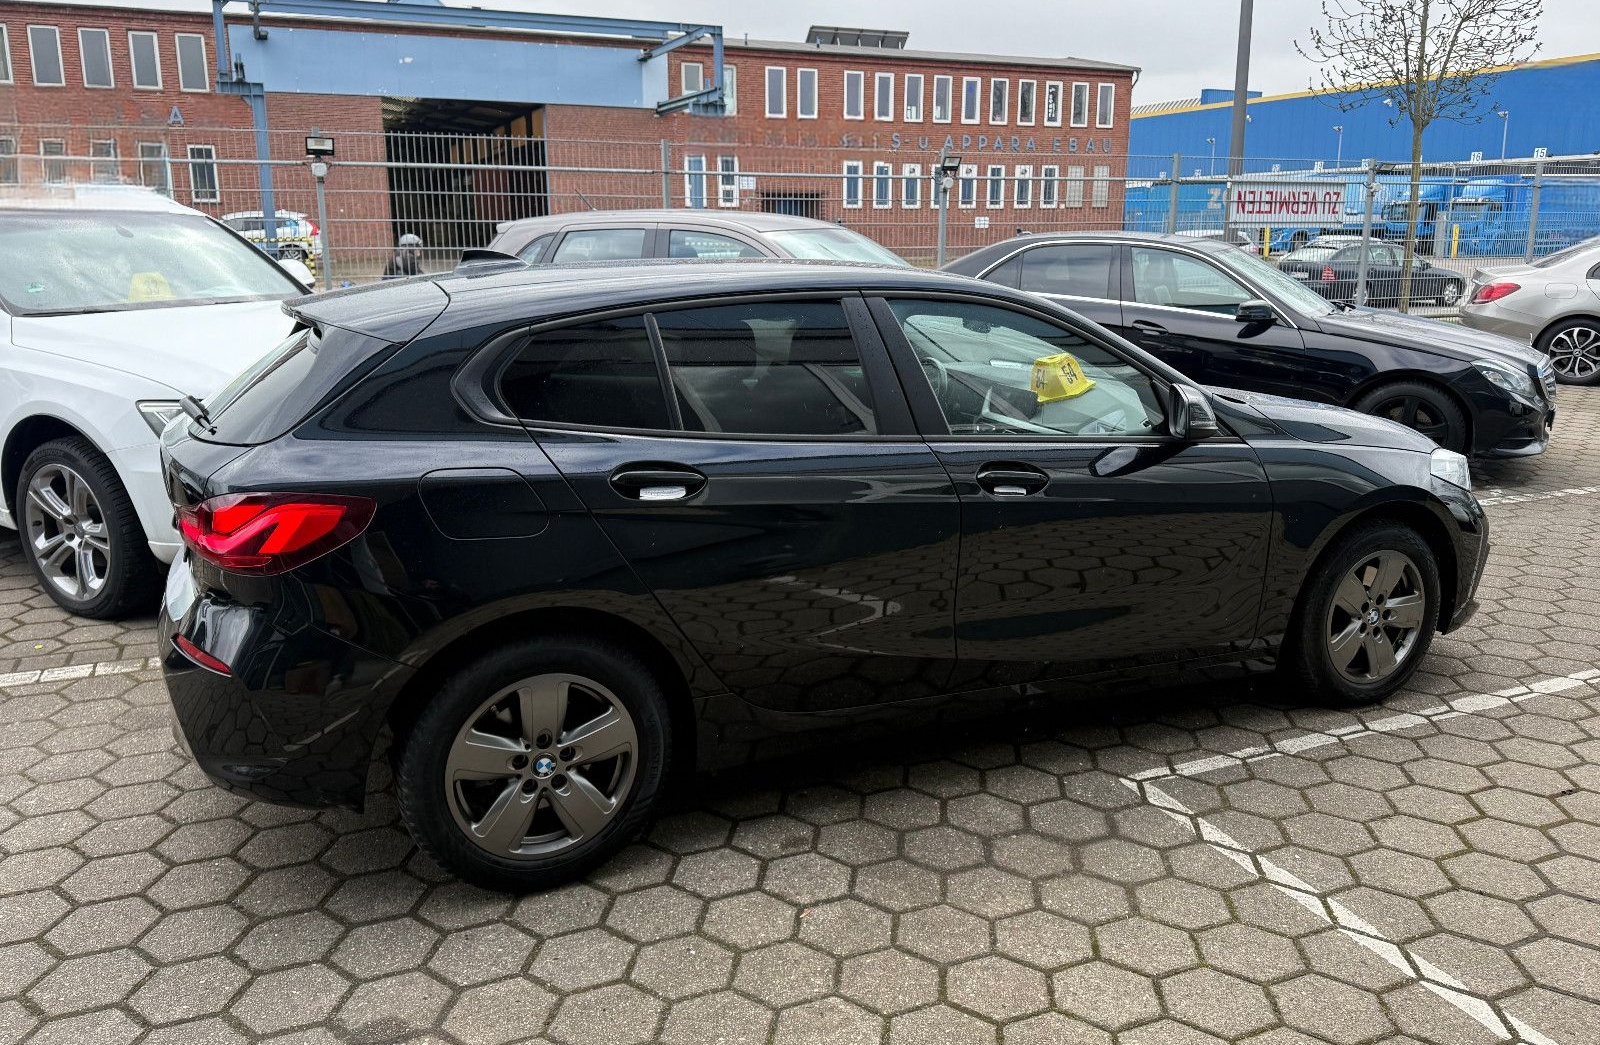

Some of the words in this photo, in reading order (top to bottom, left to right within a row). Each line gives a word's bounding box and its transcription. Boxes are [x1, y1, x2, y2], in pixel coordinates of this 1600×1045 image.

[1535, 148, 1546, 158] 15
[1236, 190, 1318, 215] VERMIETEN
[1322, 191, 1341, 215] ZU
[1061, 362, 1078, 384] 54
